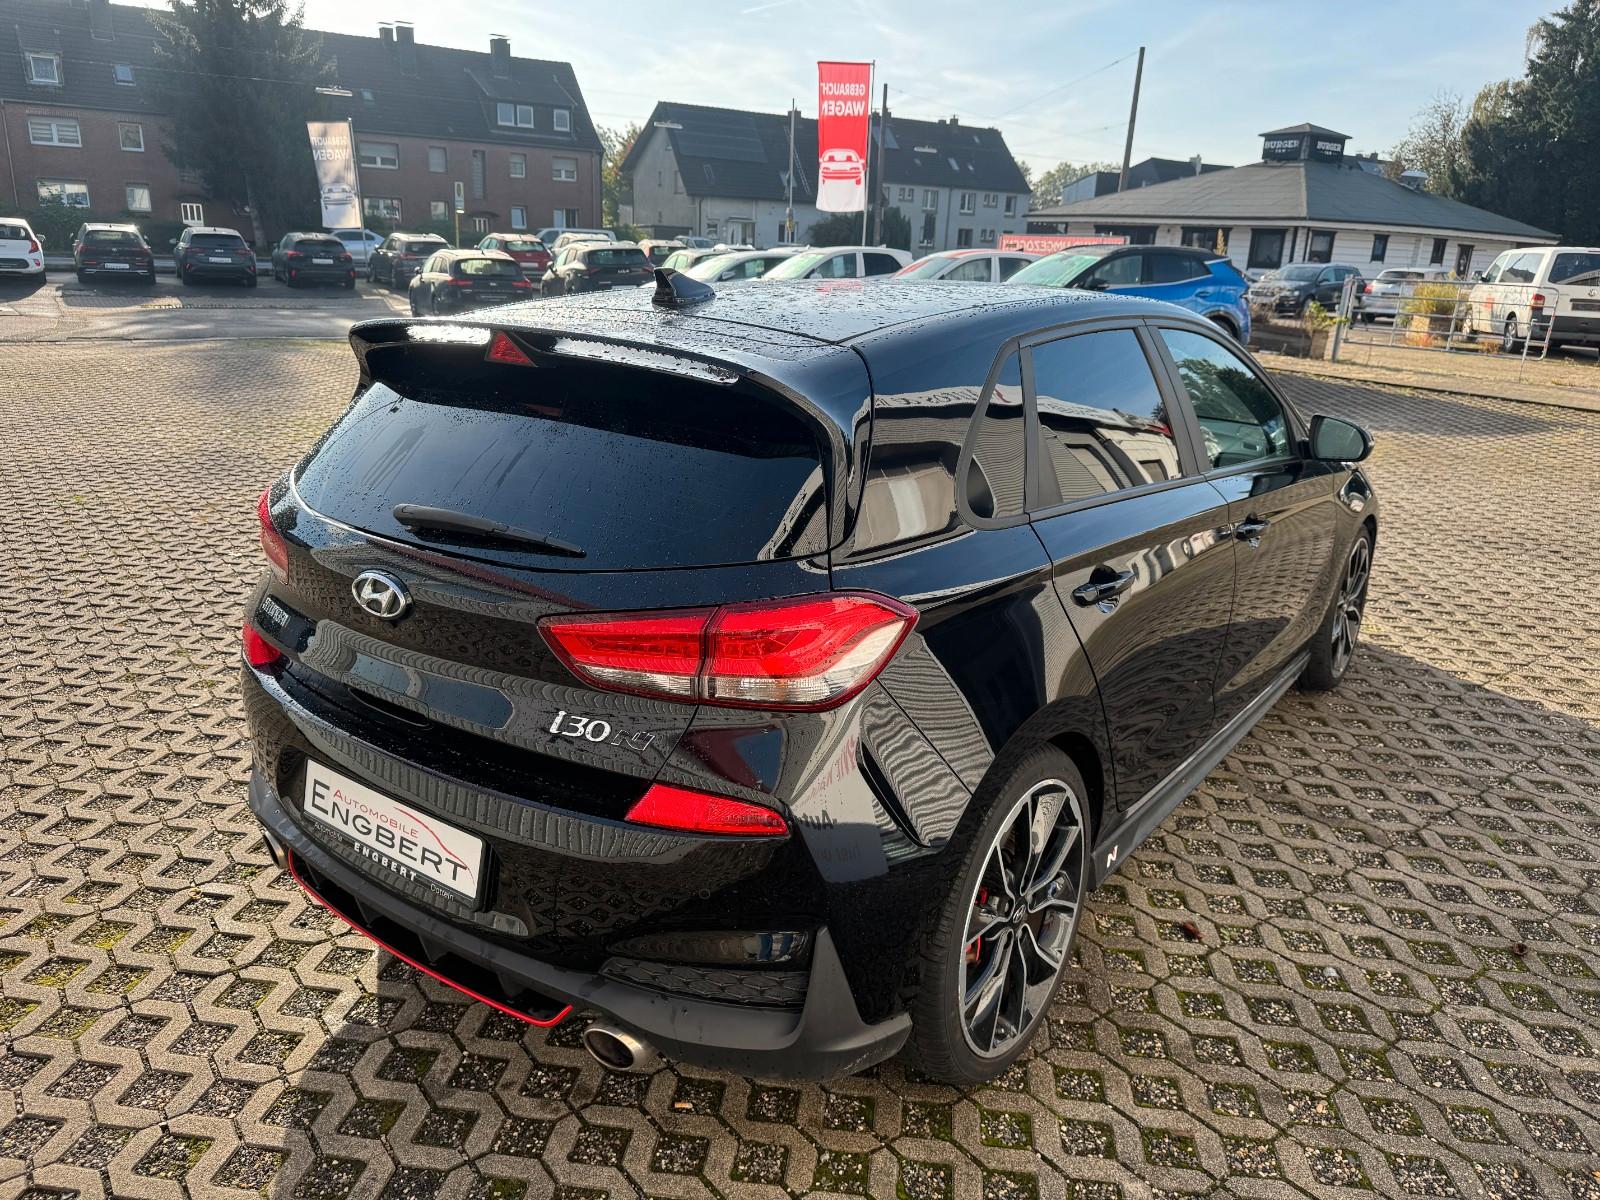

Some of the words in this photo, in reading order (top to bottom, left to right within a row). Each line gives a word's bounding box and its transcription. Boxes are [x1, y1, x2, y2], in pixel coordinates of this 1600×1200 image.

[1317, 140, 1342, 152] BURGER
[311, 779, 469, 882] ENGBERT
[333, 789, 419, 839] AUTOMOBILE
[354, 841, 417, 881] ENGBERT
